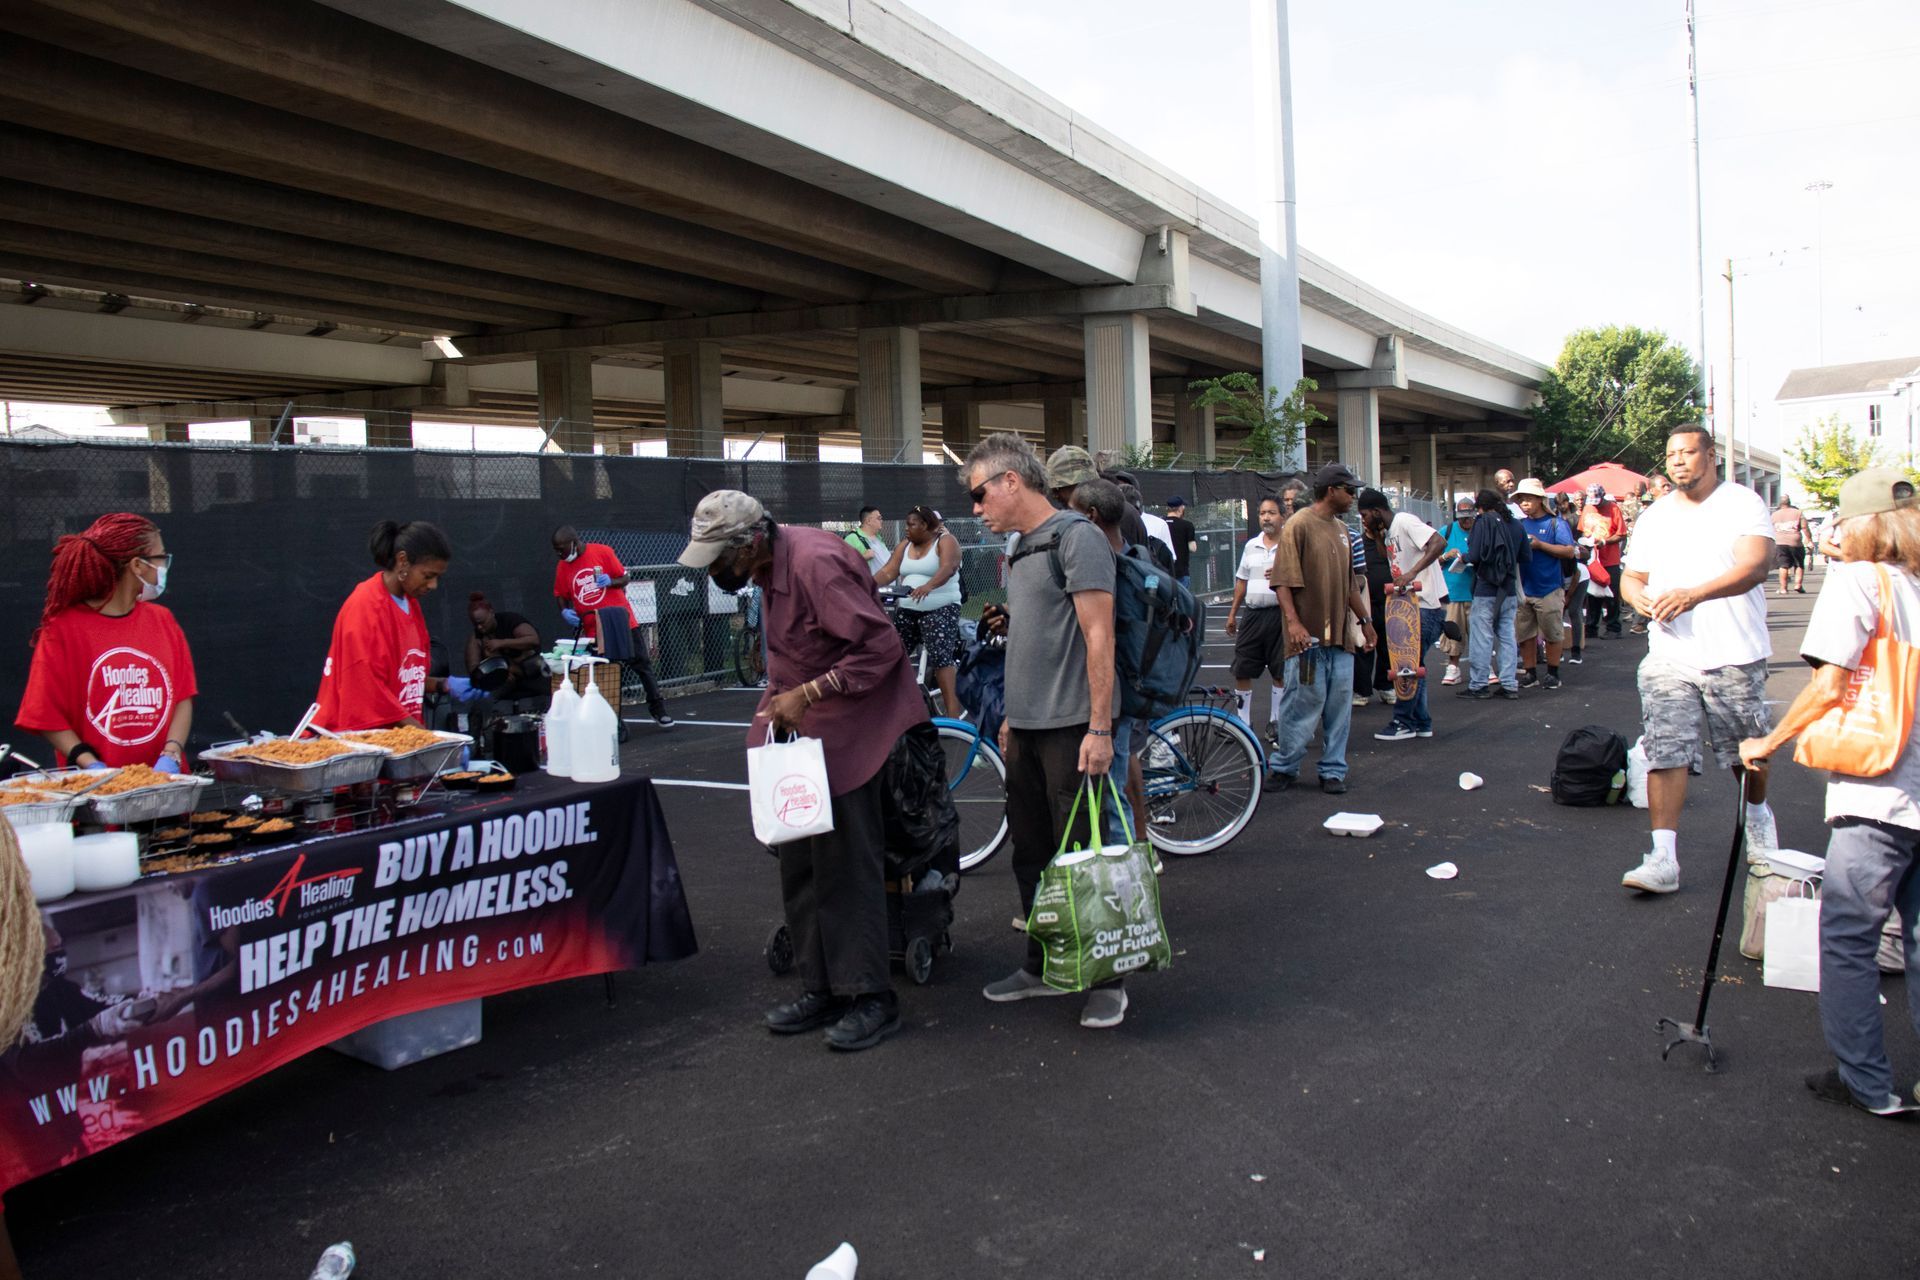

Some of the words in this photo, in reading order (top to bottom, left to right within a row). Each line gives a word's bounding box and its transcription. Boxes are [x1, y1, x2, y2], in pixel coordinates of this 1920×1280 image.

[102, 663, 149, 687] Hoodies
[119, 683, 162, 710] Healing
[374, 829, 449, 889] BUY
[449, 826, 474, 873] A
[478, 801, 598, 864] HOODIE.
[210, 898, 275, 931] Hoodies
[300, 874, 355, 908] Healing
[240, 920, 327, 994] HELP
[332, 899, 397, 958] THE
[397, 860, 574, 938] HOMELESS.
[1095, 929, 1123, 944] Our
[1092, 943, 1121, 959] Our
